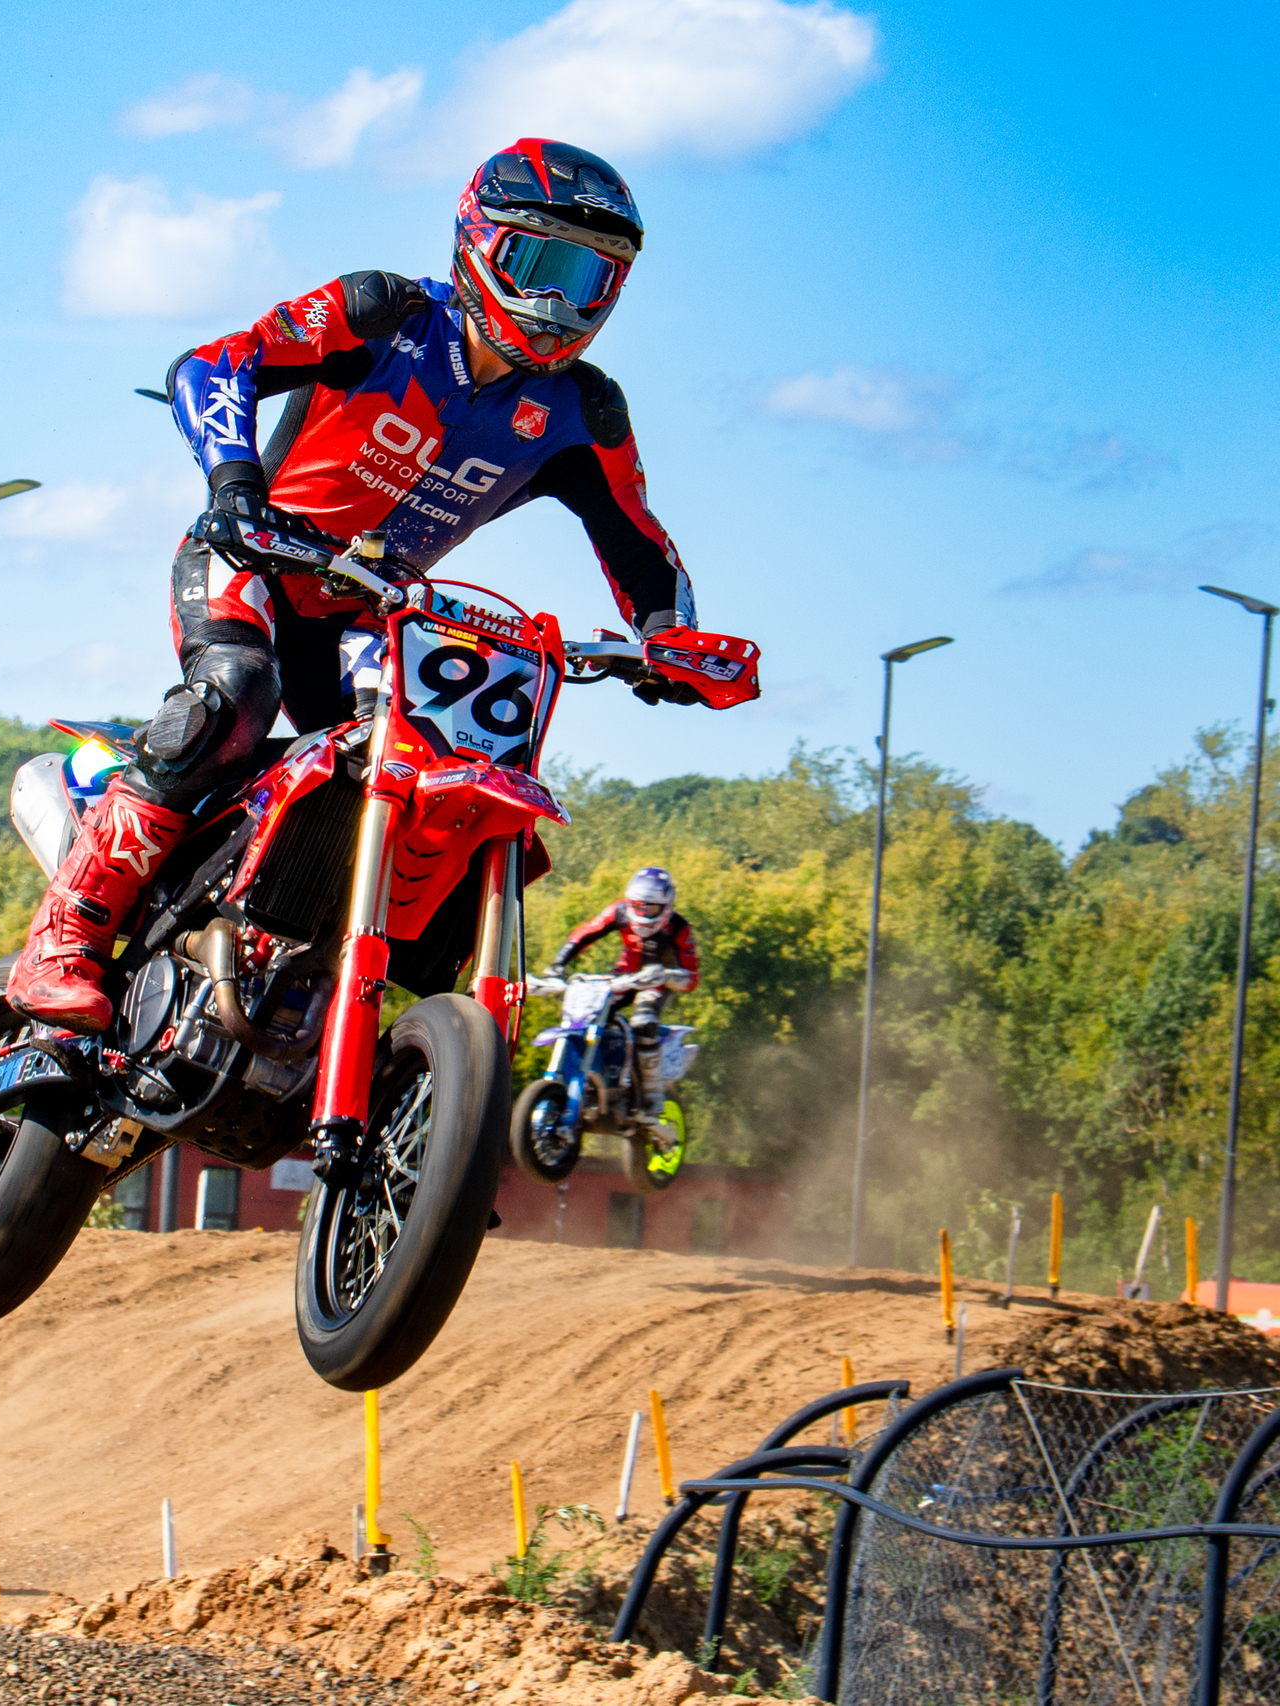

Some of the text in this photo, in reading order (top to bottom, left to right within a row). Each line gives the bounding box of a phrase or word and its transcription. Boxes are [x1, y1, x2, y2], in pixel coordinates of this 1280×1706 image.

[448, 341, 470, 386] MOSIN
[372, 412, 506, 493] OLG
[359, 441, 480, 507] MOTORSPORT
[423, 621, 479, 643] IVAN MOSIN
[461, 612, 526, 641] NTHAL
[463, 601, 526, 628] NTHAL
[418, 644, 537, 737] 96
[457, 731, 494, 750] OLG
